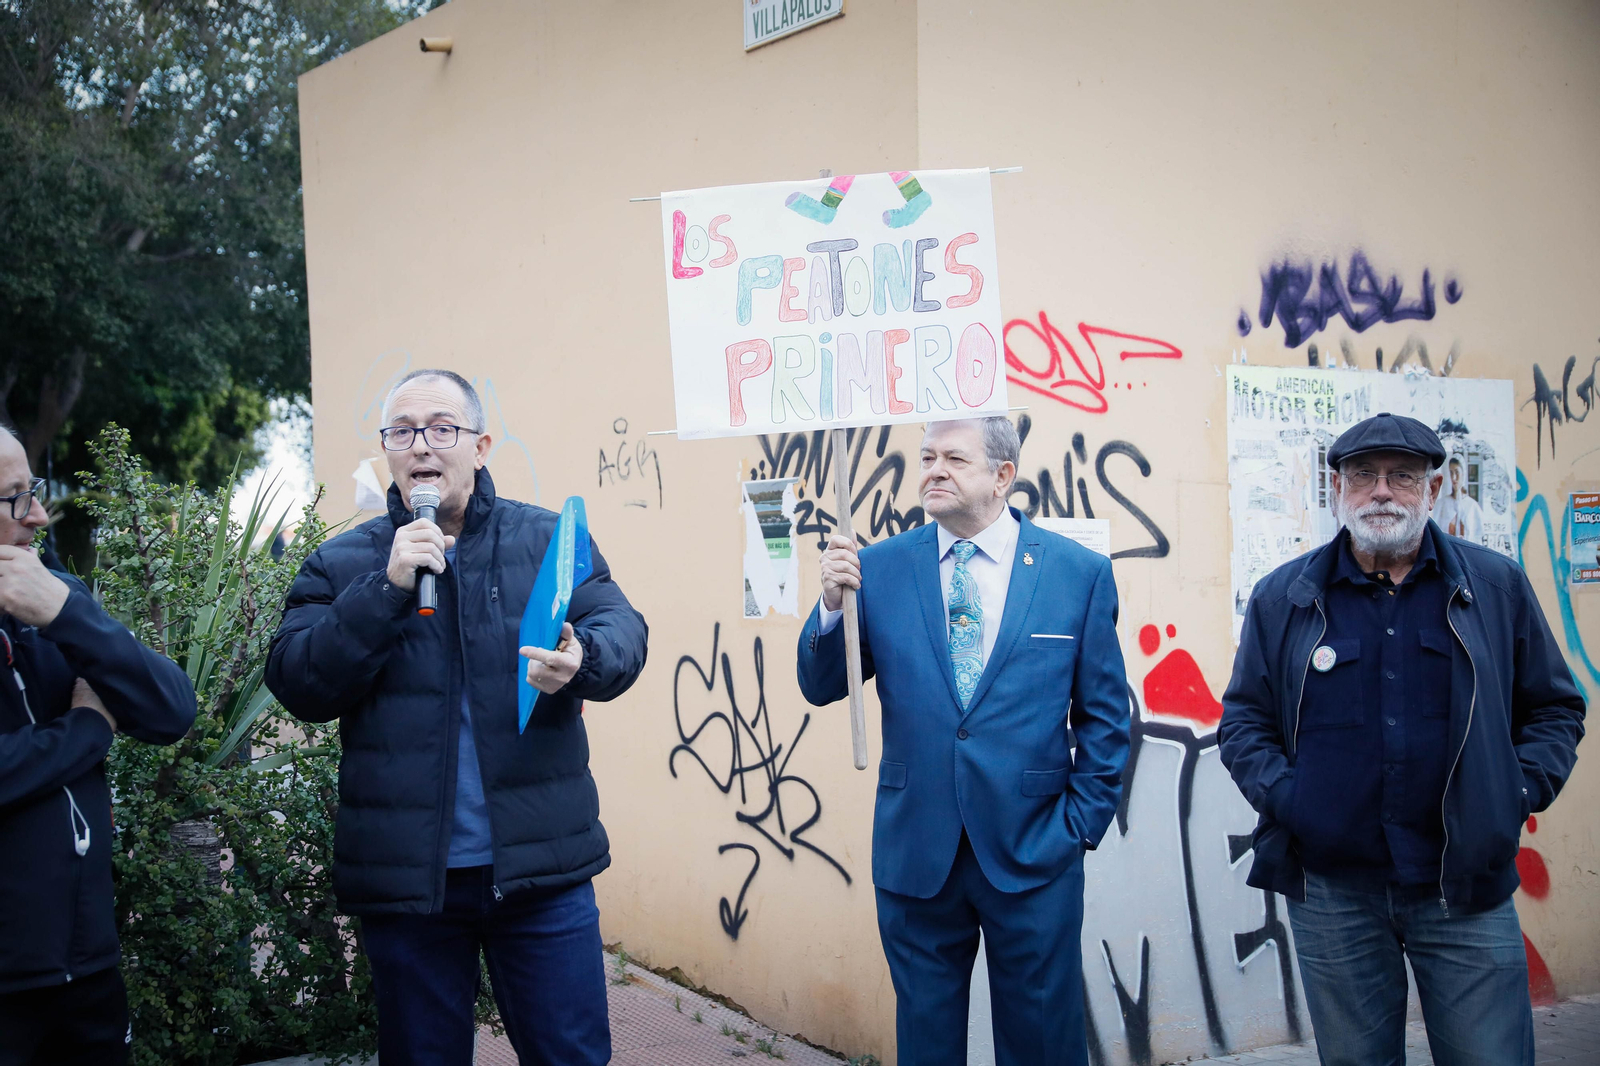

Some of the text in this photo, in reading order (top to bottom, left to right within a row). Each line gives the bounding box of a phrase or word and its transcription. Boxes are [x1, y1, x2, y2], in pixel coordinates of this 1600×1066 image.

[672, 209, 738, 279] LOS
[736, 232, 984, 326] PEATONES
[1232, 374, 1372, 425] MOTOR SHOW
[1275, 376, 1334, 396] AMERICAN
